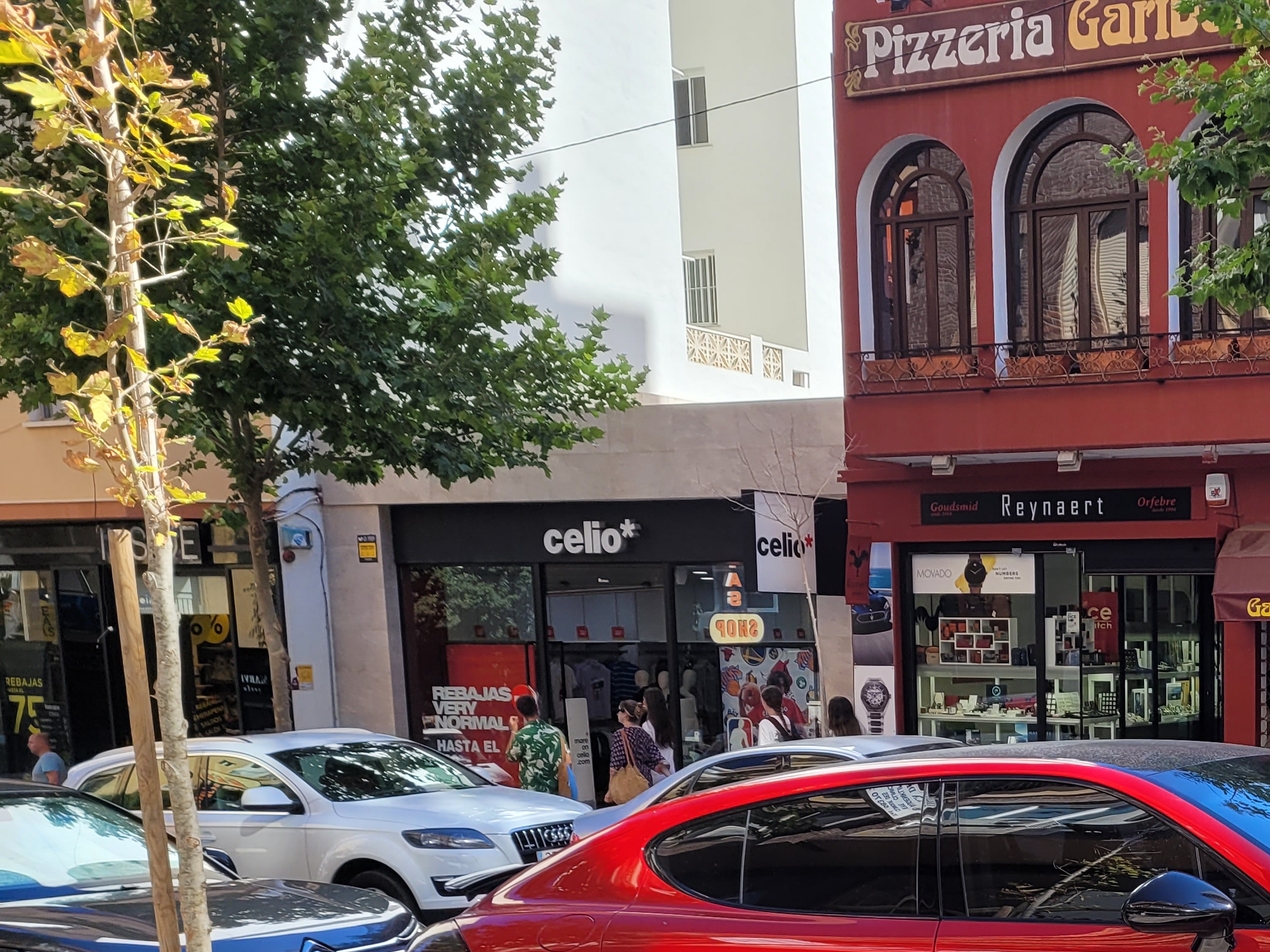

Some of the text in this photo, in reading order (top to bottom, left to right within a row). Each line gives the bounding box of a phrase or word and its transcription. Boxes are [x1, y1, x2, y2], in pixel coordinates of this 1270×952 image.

[862, 6, 1054, 78] Pizzeria
[930, 500, 979, 512] Goudsmid
[1001, 494, 1104, 521] Reynaert
[1137, 495, 1177, 509] Orfebre
[916, 569, 953, 579] MOVADO
[6, 676, 44, 688] REBAJAS
[431, 686, 513, 702] REBAJAS
[8, 695, 45, 735] 75
[432, 700, 478, 716] VERY
[434, 715, 510, 731] NORMAL
[437, 739, 501, 753] HASTA EL
